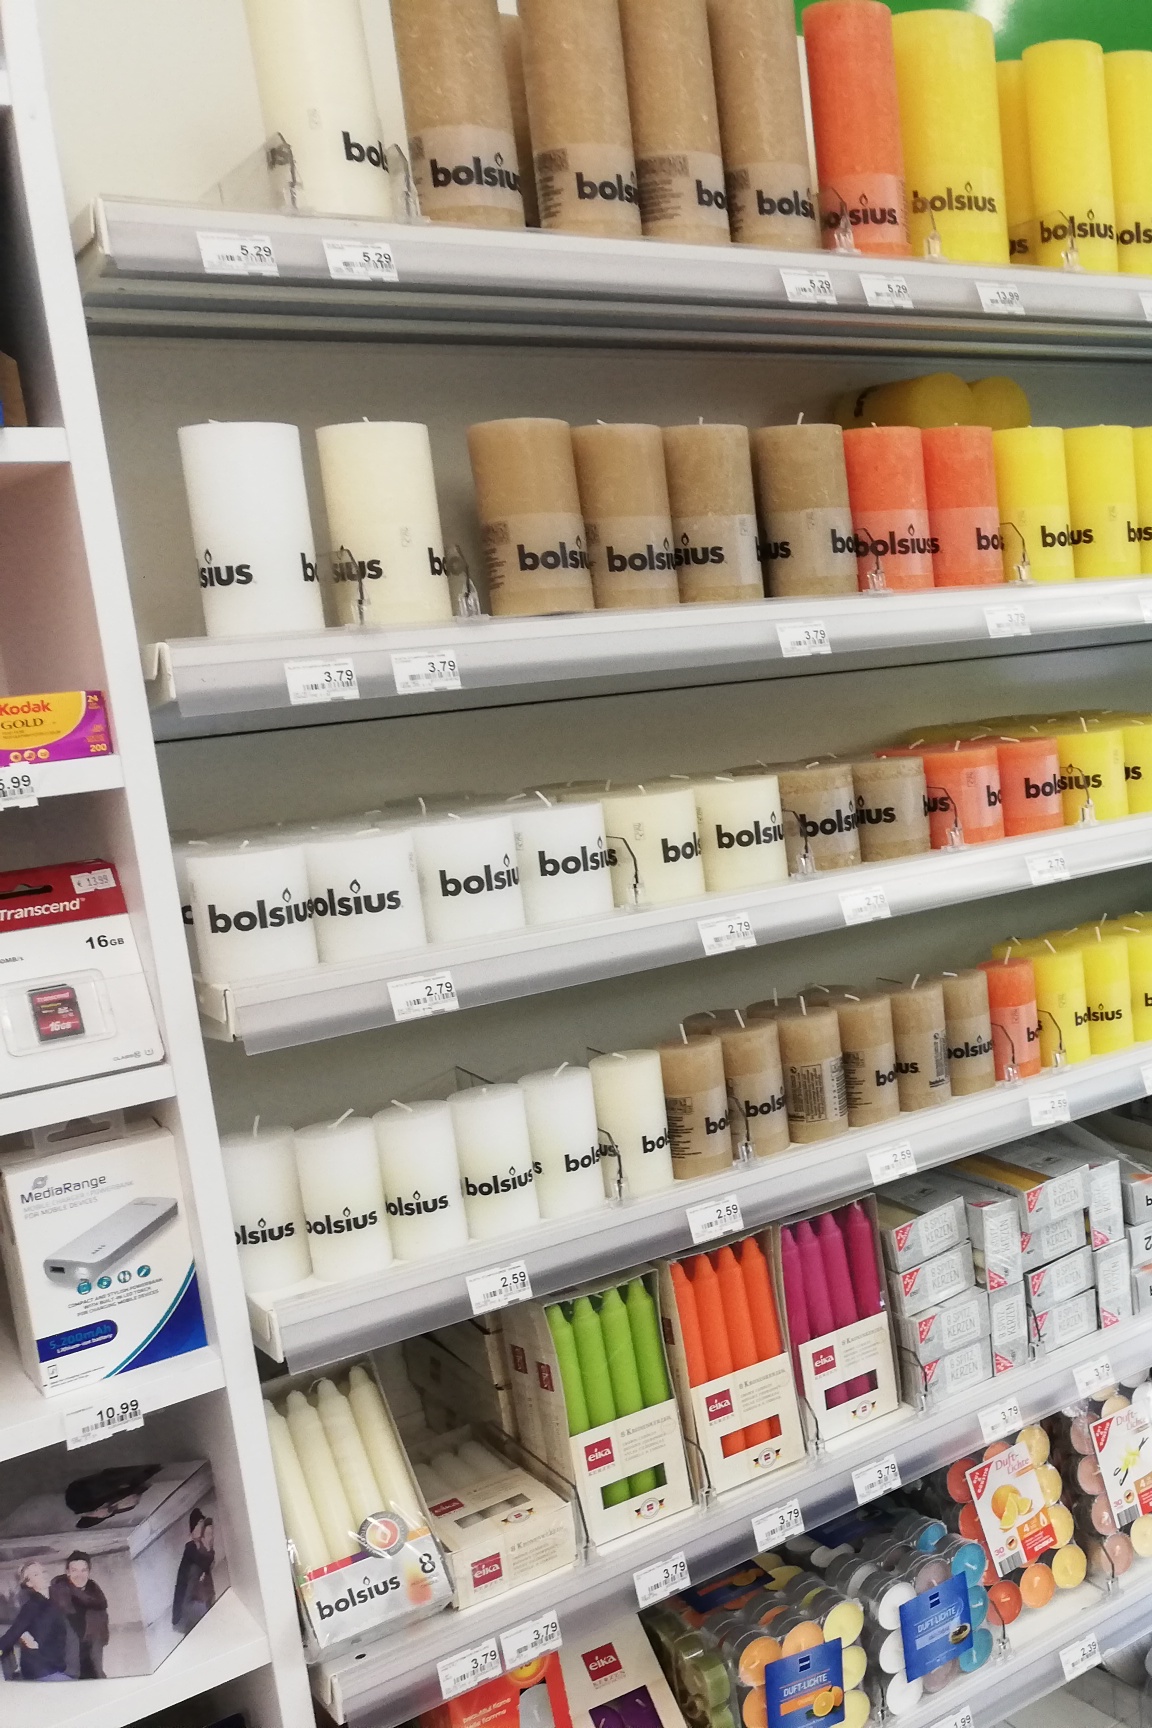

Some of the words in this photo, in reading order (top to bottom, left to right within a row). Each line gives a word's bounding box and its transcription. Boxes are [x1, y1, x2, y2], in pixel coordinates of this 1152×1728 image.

[912, 181, 997, 215] bolsius
[1040, 209, 1114, 244] bolsius
[240, 244, 272, 258] 5.29
[362, 250, 392, 265] 5.29
[809, 279, 831, 290] 5.29
[887, 284, 908, 294] 5.29
[1007, 612, 1026, 624] 3.79
[804, 629, 826, 640] 3.79
[427, 659, 456, 674] 3.79
[324, 668, 355, 684] 3.79
[0, 700, 52, 716] Kodak
[1, 718, 44, 730] GOLD
[90, 743, 107, 752] 200
[1049, 858, 1066, 869] 2.79
[864, 895, 886, 907] 2.79
[0, 897, 81, 922] Transcend
[727, 922, 750, 935] 2.79
[424, 981, 453, 998] 2.79
[1050, 1100, 1067, 1110] 2.59
[892, 1149, 912, 1162] 2.59
[20, 1174, 107, 1205] MediaRange
[715, 1204, 739, 1220] 2.59
[500, 1270, 527, 1288] 2.59
[814, 1354, 835, 1367] eika
[1094, 1363, 1111, 1378] 3.79
[97, 1399, 140, 1422] 10.99
[708, 1398, 731, 1413] eika
[1001, 1405, 1019, 1420] 3.79
[1116, 1408, 1138, 1427] Duft-
[587, 1447, 612, 1463] eika
[995, 1451, 1019, 1471] Duft-
[877, 1463, 897, 1480] 3.79
[1007, 1457, 1029, 1475] Lichte
[778, 1508, 801, 1527] 3.79
[1023, 1523, 1030, 1533] 4
[994, 1546, 1004, 1557] 30
[419, 1552, 436, 1574] 8
[663, 1561, 687, 1580] 3.79
[474, 1563, 501, 1580] eika
[316, 1575, 401, 1621] bolsius
[533, 1622, 559, 1640] 3.79
[1080, 1641, 1097, 1657] 2.39
[471, 1650, 497, 1670] 3.79
[588, 1653, 617, 1672] eika
[783, 1673, 828, 1698] DUFT-LICHTE
